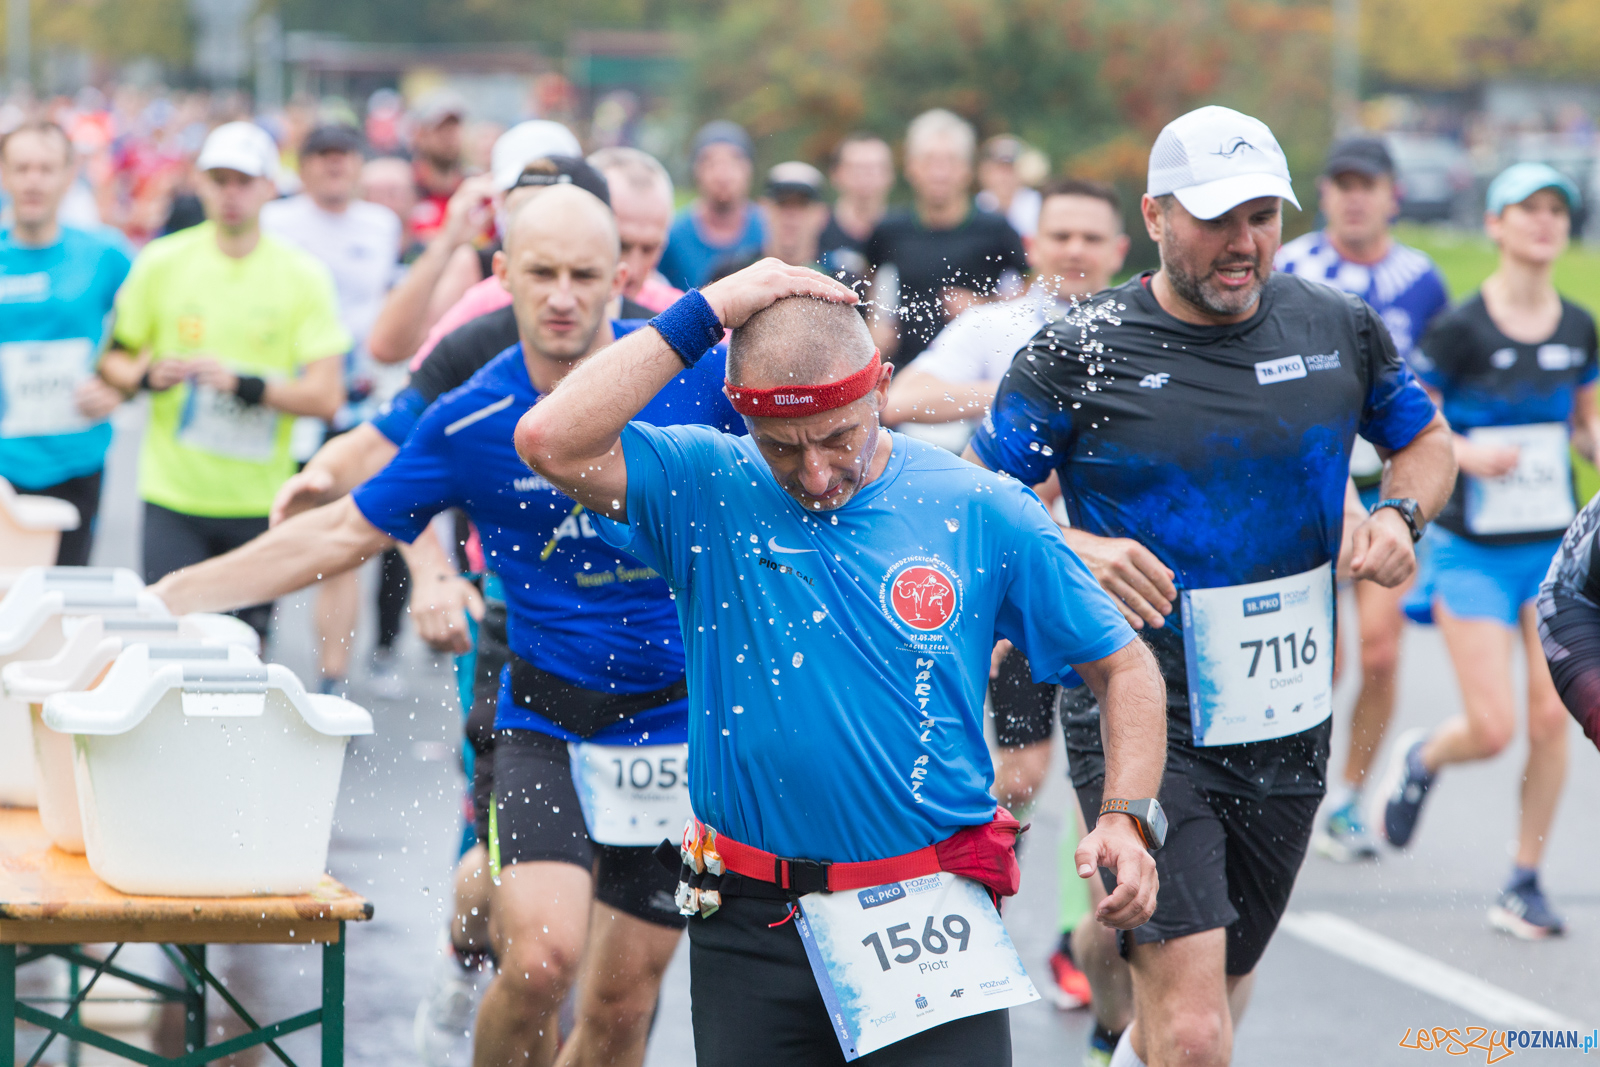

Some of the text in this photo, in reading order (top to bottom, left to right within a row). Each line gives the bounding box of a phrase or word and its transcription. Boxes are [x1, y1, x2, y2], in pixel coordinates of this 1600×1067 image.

[1278, 362, 1300, 373] PKO
[1309, 360, 1341, 371] maraton
[774, 394, 814, 405] Wilson
[759, 557, 793, 575] PIOTR
[1260, 598, 1279, 609] PKO
[910, 634, 943, 642] 21.03.2015
[1240, 626, 1317, 678] 7116
[1270, 673, 1303, 690] Dawid
[612, 758, 688, 789] 105
[910, 755, 930, 804] ARTS
[878, 887, 901, 902] PKO
[908, 881, 943, 894] maraton
[861, 914, 971, 972] 1569
[918, 959, 949, 975] Piotr
[950, 988, 964, 998] 4F
